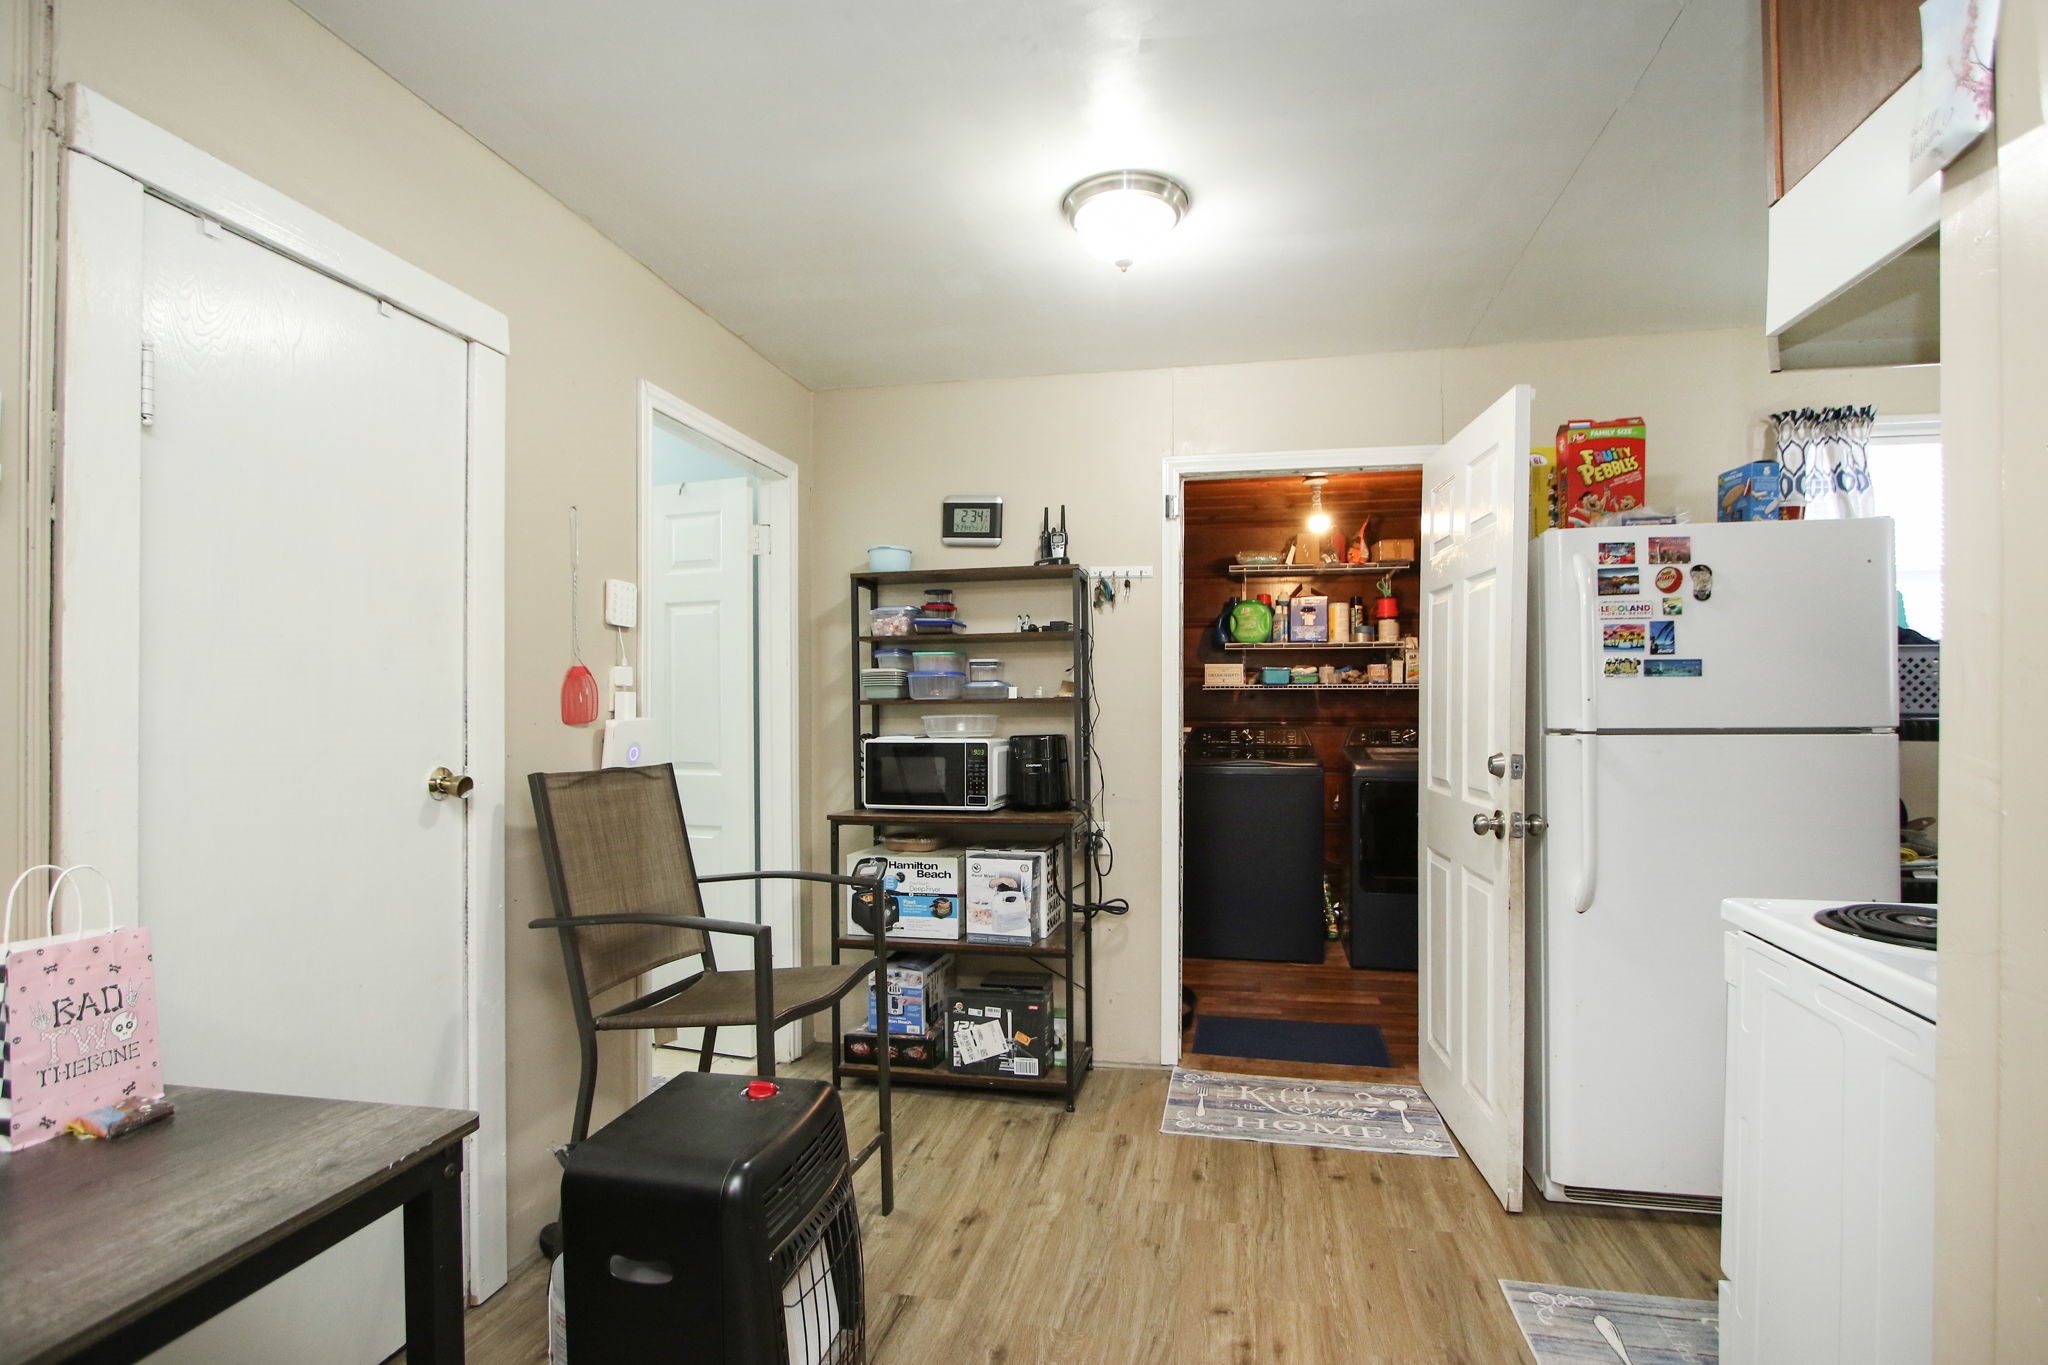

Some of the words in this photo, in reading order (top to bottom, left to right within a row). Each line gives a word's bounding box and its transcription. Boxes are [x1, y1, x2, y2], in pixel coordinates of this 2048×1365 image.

[1590, 429, 1615, 437] FAMILY
[1577, 456, 1639, 486] PEBBLES
[1600, 604, 1651, 613] LEGOLAND
[888, 860, 939, 871] Hamilton
[916, 869, 952, 879] Beach
[53, 984, 124, 1028] BAD
[1239, 1085, 1355, 1113] Kitchen
[1235, 1116, 1388, 1140] HOME
